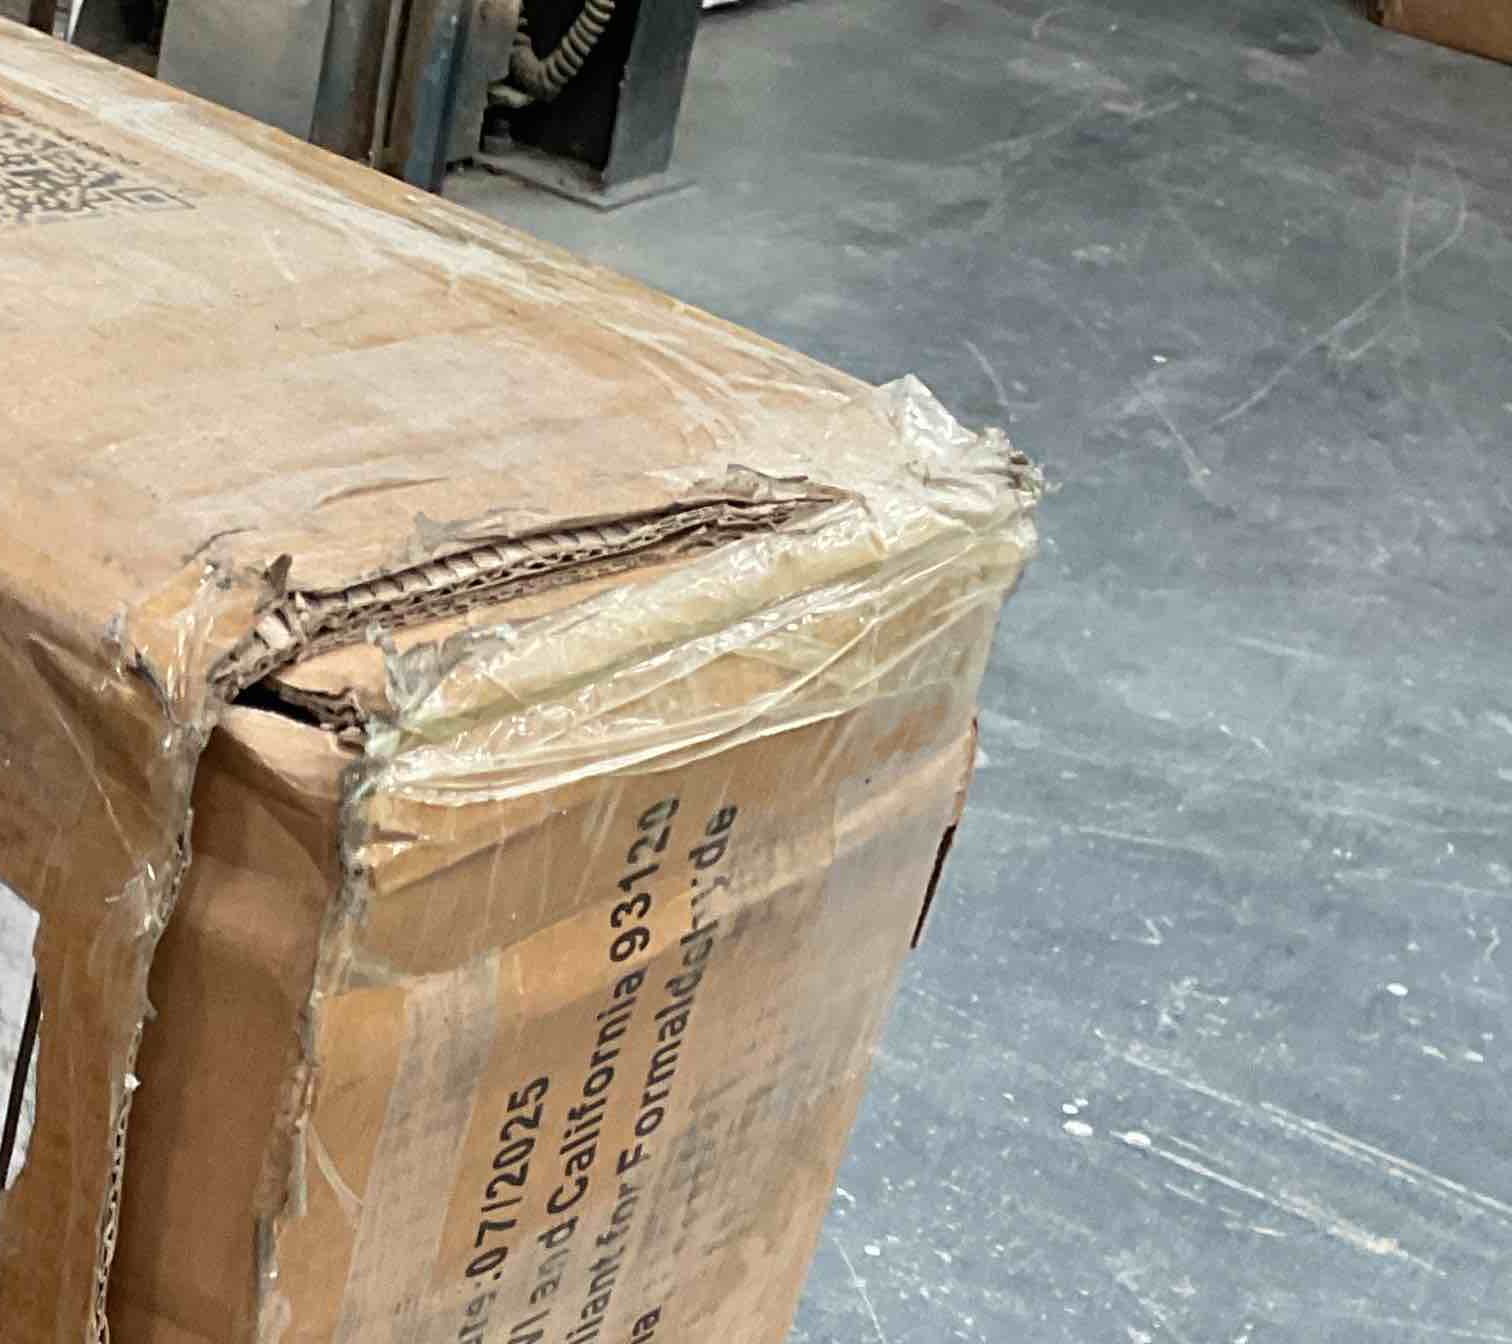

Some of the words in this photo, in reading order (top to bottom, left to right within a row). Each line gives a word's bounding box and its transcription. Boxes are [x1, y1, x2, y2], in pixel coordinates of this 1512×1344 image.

[609, 795, 681, 965] 93120
[547, 963, 648, 1219] California
[529, 1215, 581, 1307] and
[595, 1178, 641, 1255] for
